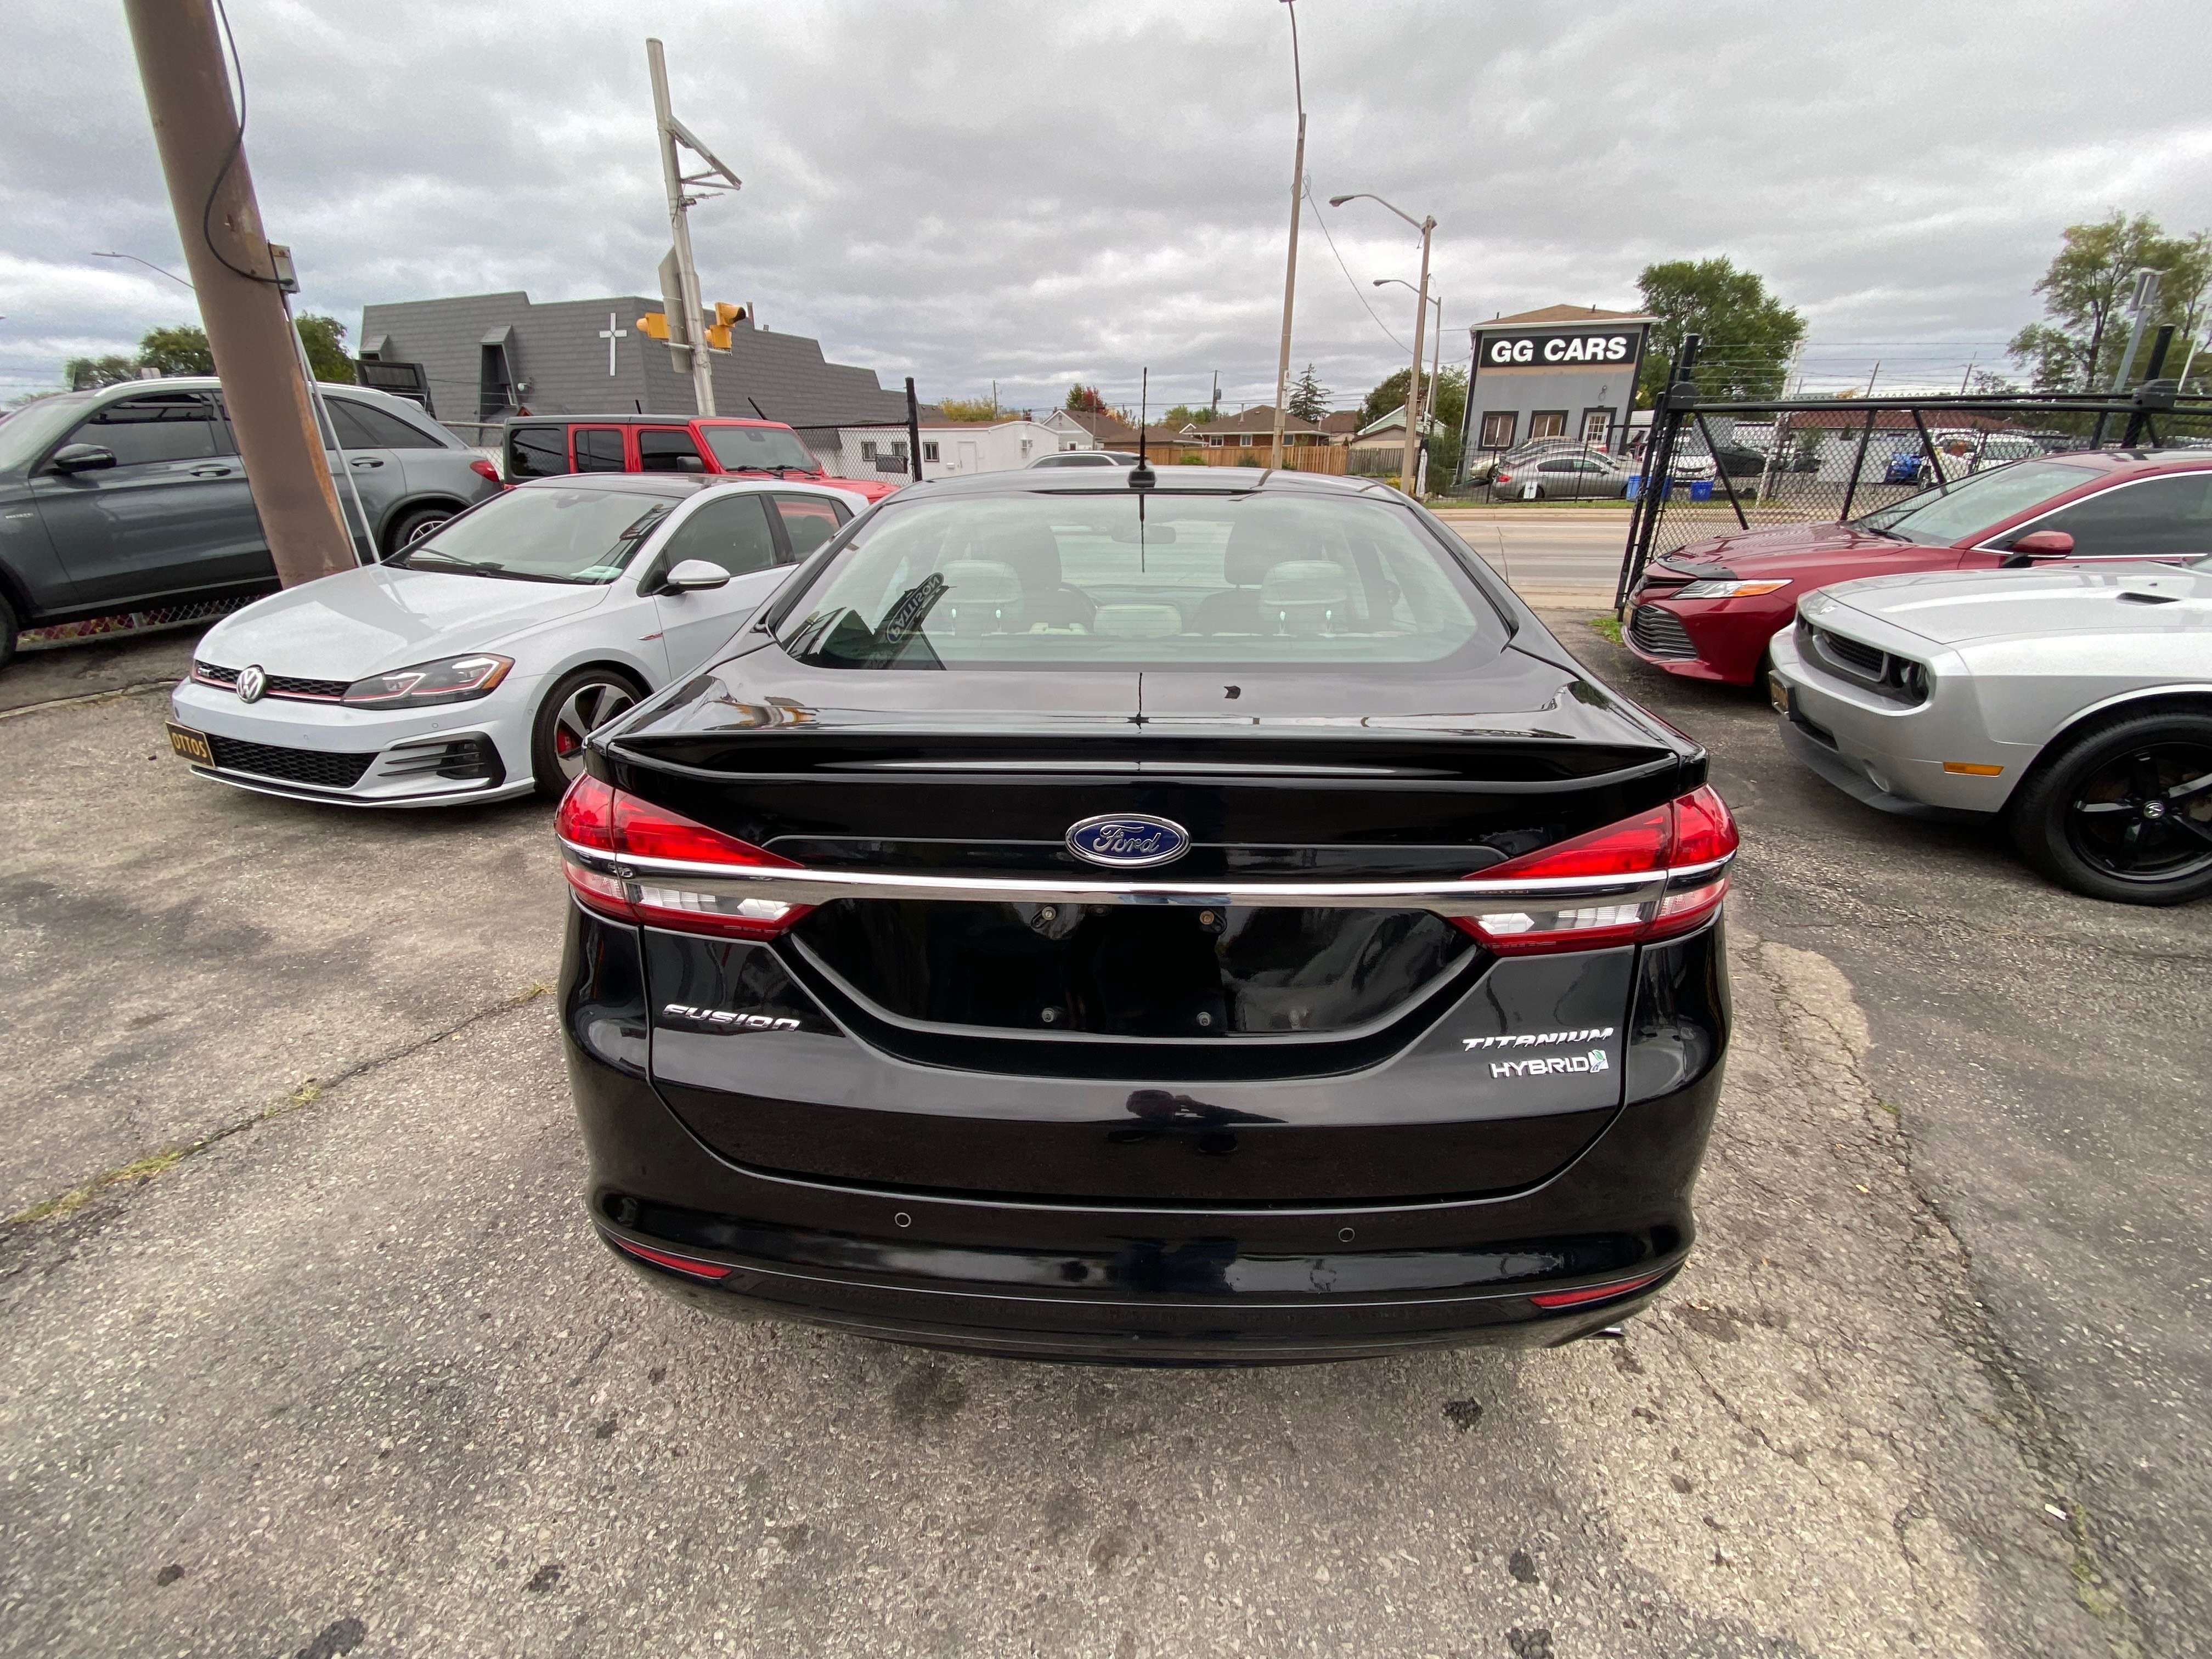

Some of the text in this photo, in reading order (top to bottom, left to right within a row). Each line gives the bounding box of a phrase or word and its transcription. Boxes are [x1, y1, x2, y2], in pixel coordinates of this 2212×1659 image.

[1491, 336, 1627, 363] GG CARS
[172, 732, 207, 758] OTTOS
[1093, 825, 1161, 853] Ford
[662, 1003, 802, 1031] FUSION
[1462, 1027, 1614, 1051] TITANIUM
[1490, 1057, 1589, 1079] HYBRID
